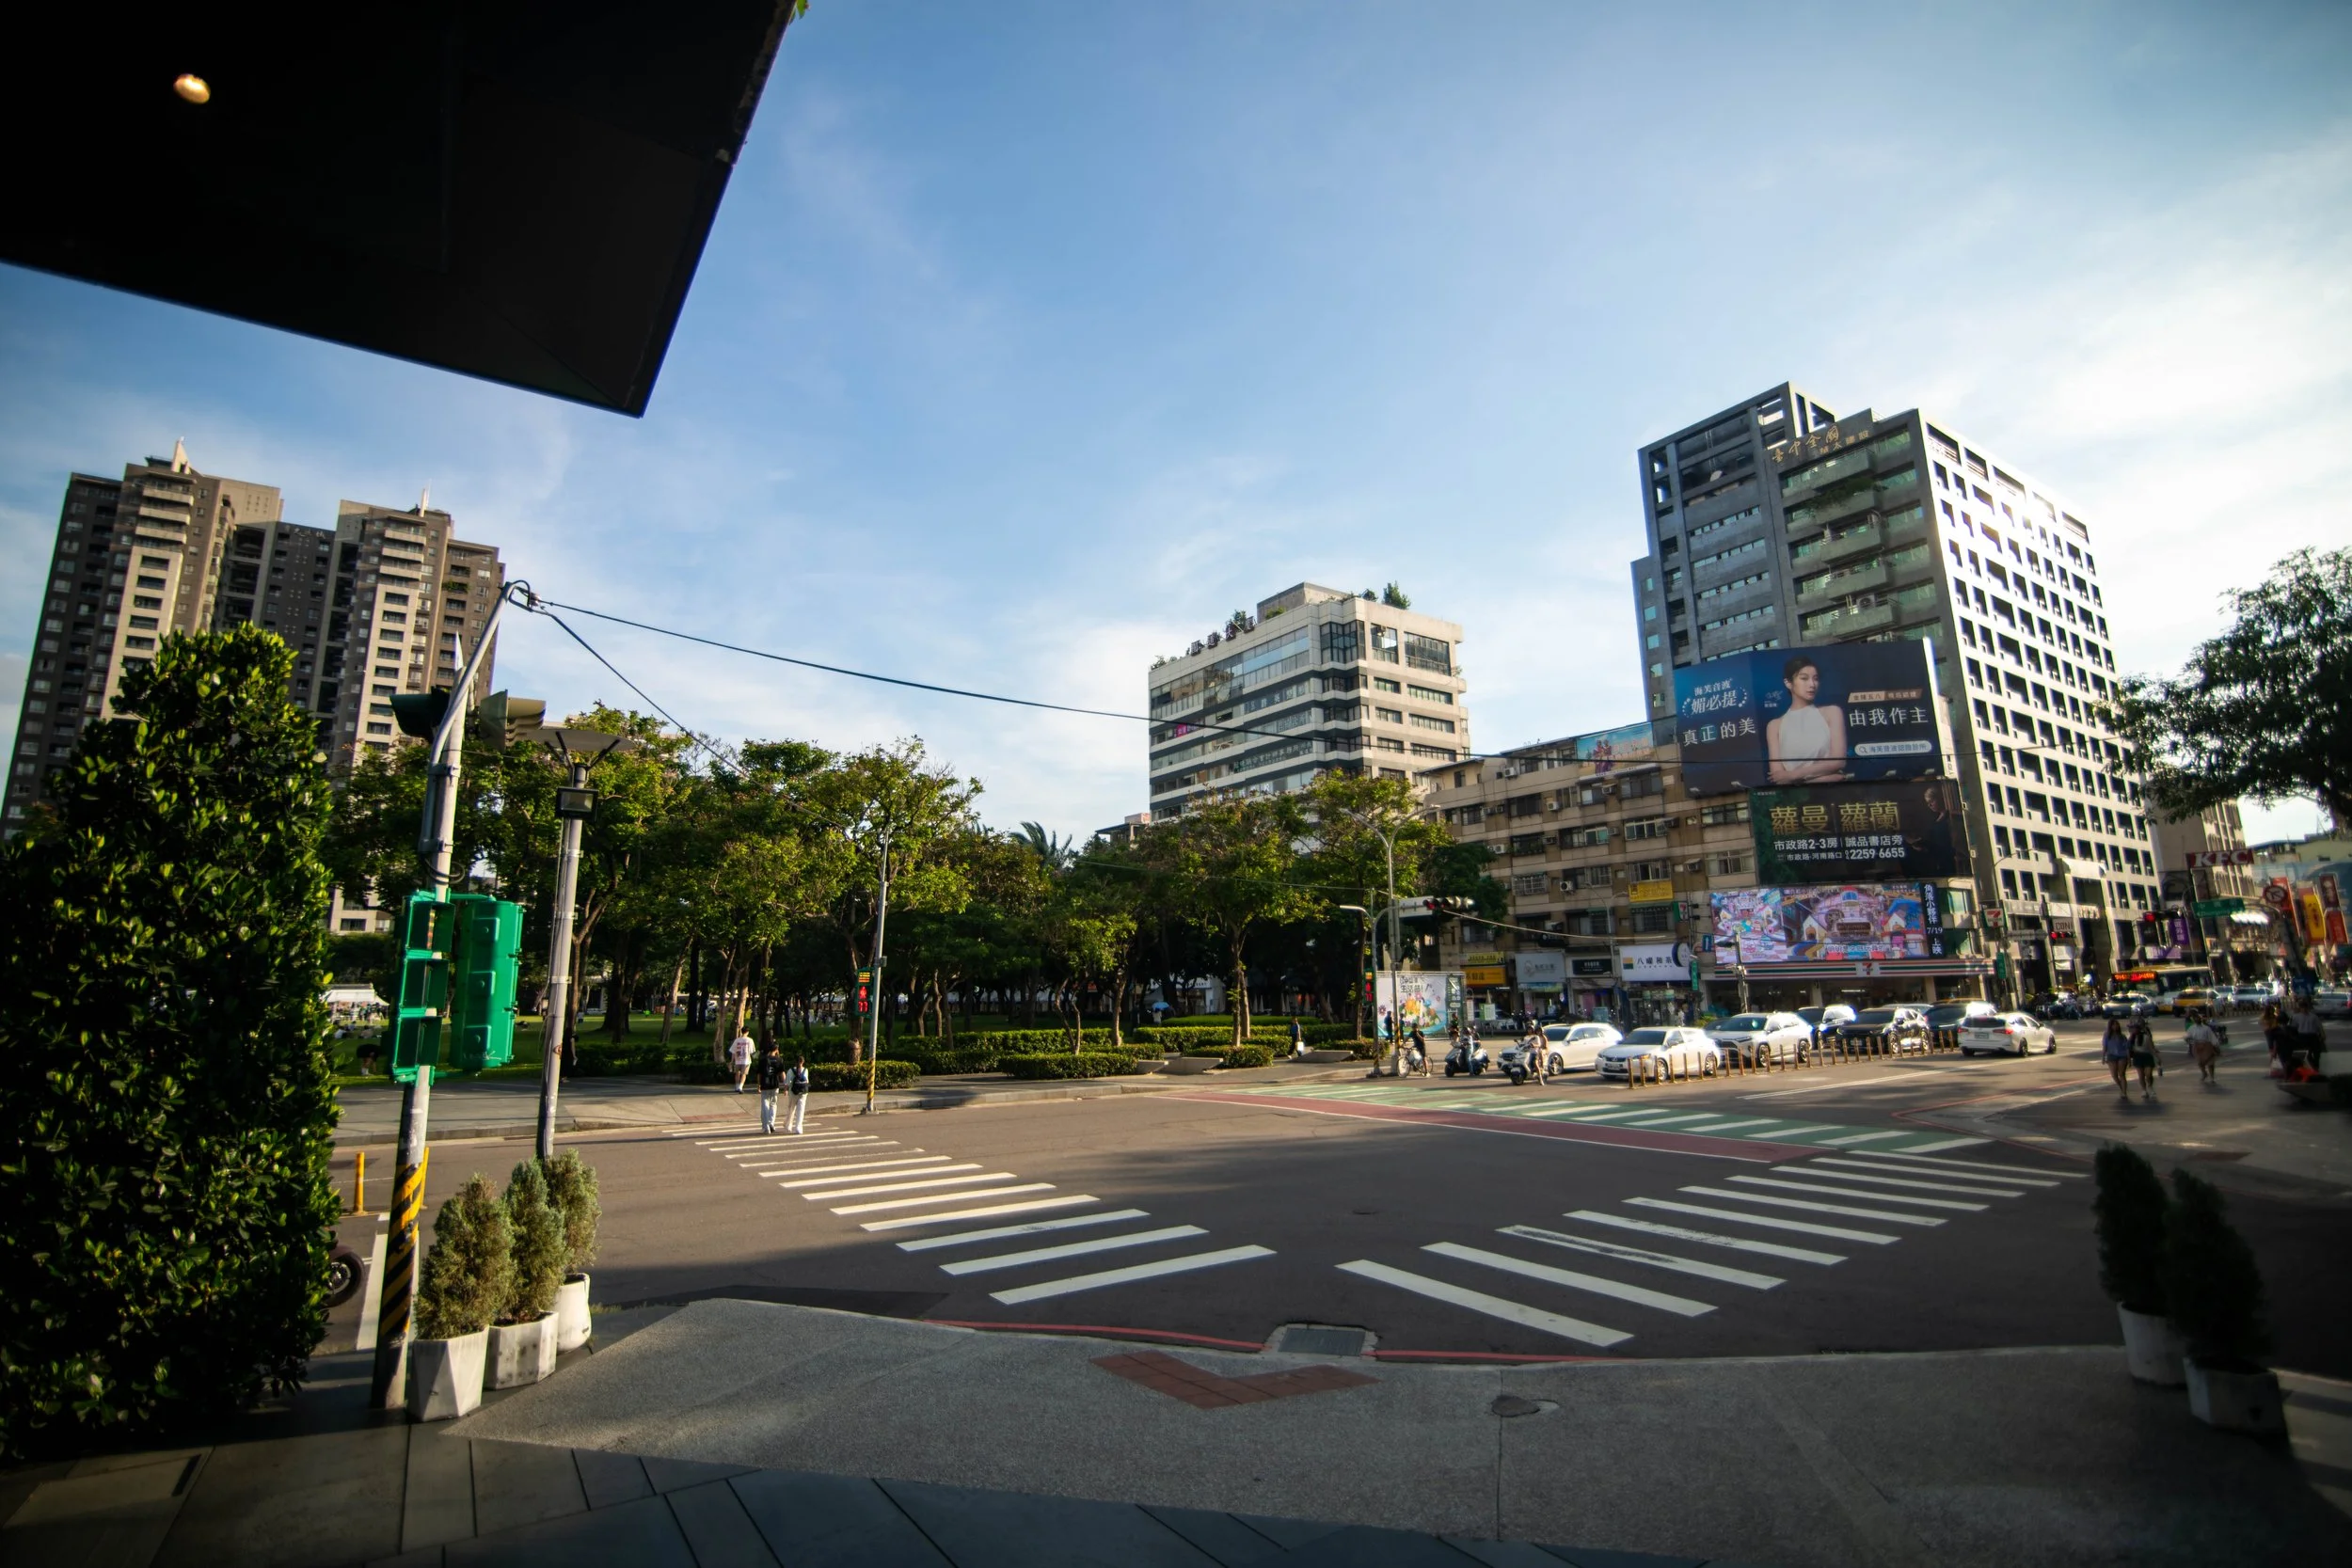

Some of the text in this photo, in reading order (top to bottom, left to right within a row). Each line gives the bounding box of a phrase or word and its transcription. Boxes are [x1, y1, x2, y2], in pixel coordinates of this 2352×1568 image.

[1849, 707, 1929, 727] 由我作主
[1683, 718, 1756, 746] 真正的美
[1770, 801, 1900, 835] 蘿曼 蘿蘭
[1845, 834, 1903, 847] 誠品書店旁
[2195, 849, 2249, 867] KFC
[1931, 938, 1943, 956] 上映
